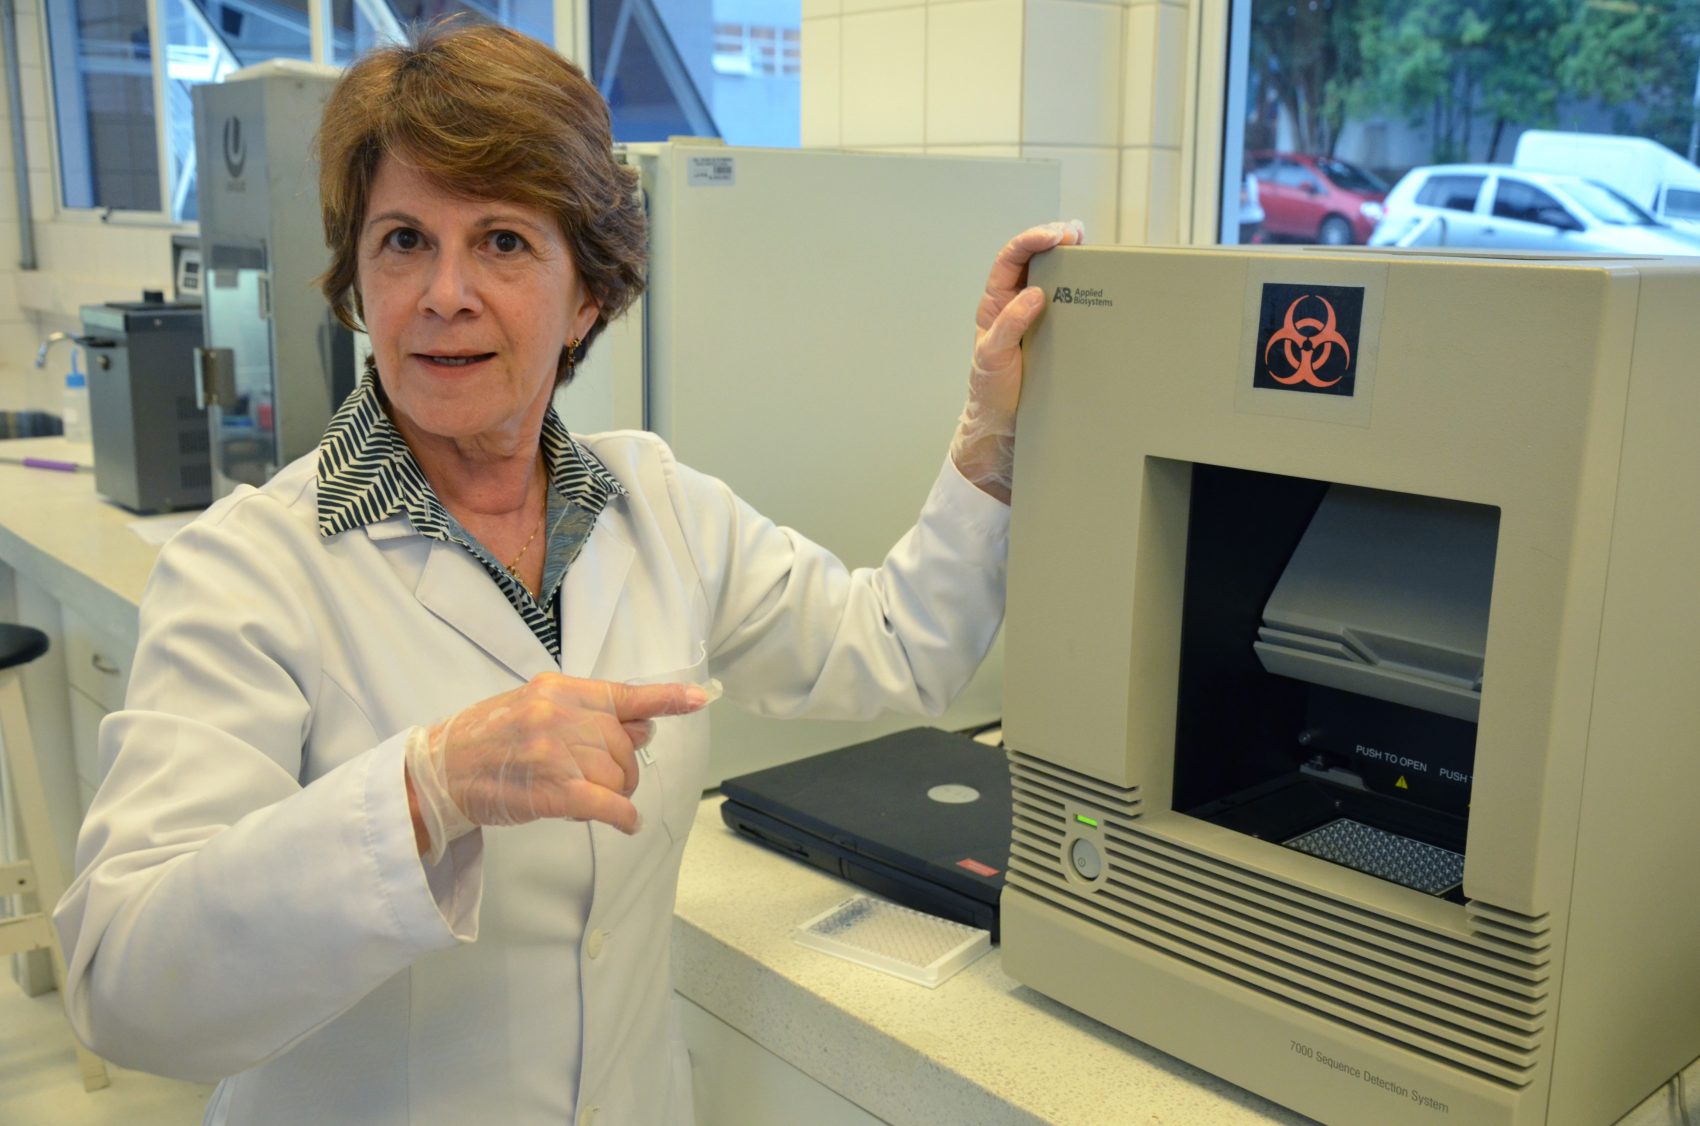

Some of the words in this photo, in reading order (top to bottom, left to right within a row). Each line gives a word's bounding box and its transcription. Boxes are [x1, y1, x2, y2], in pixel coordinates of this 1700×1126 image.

[1074, 288, 1103, 298] Applied
[1073, 296, 1113, 308] Biosystems
[1355, 745, 1382, 760] PUSH
[1384, 752, 1398, 764] TO
[1399, 757, 1428, 772] OPEN
[1439, 768, 1468, 783] PUSH
[1290, 1040, 1313, 1058] 7000
[1316, 1051, 1361, 1078] Sequence
[1363, 1070, 1409, 1098] Detection
[1411, 1089, 1449, 1114] System
